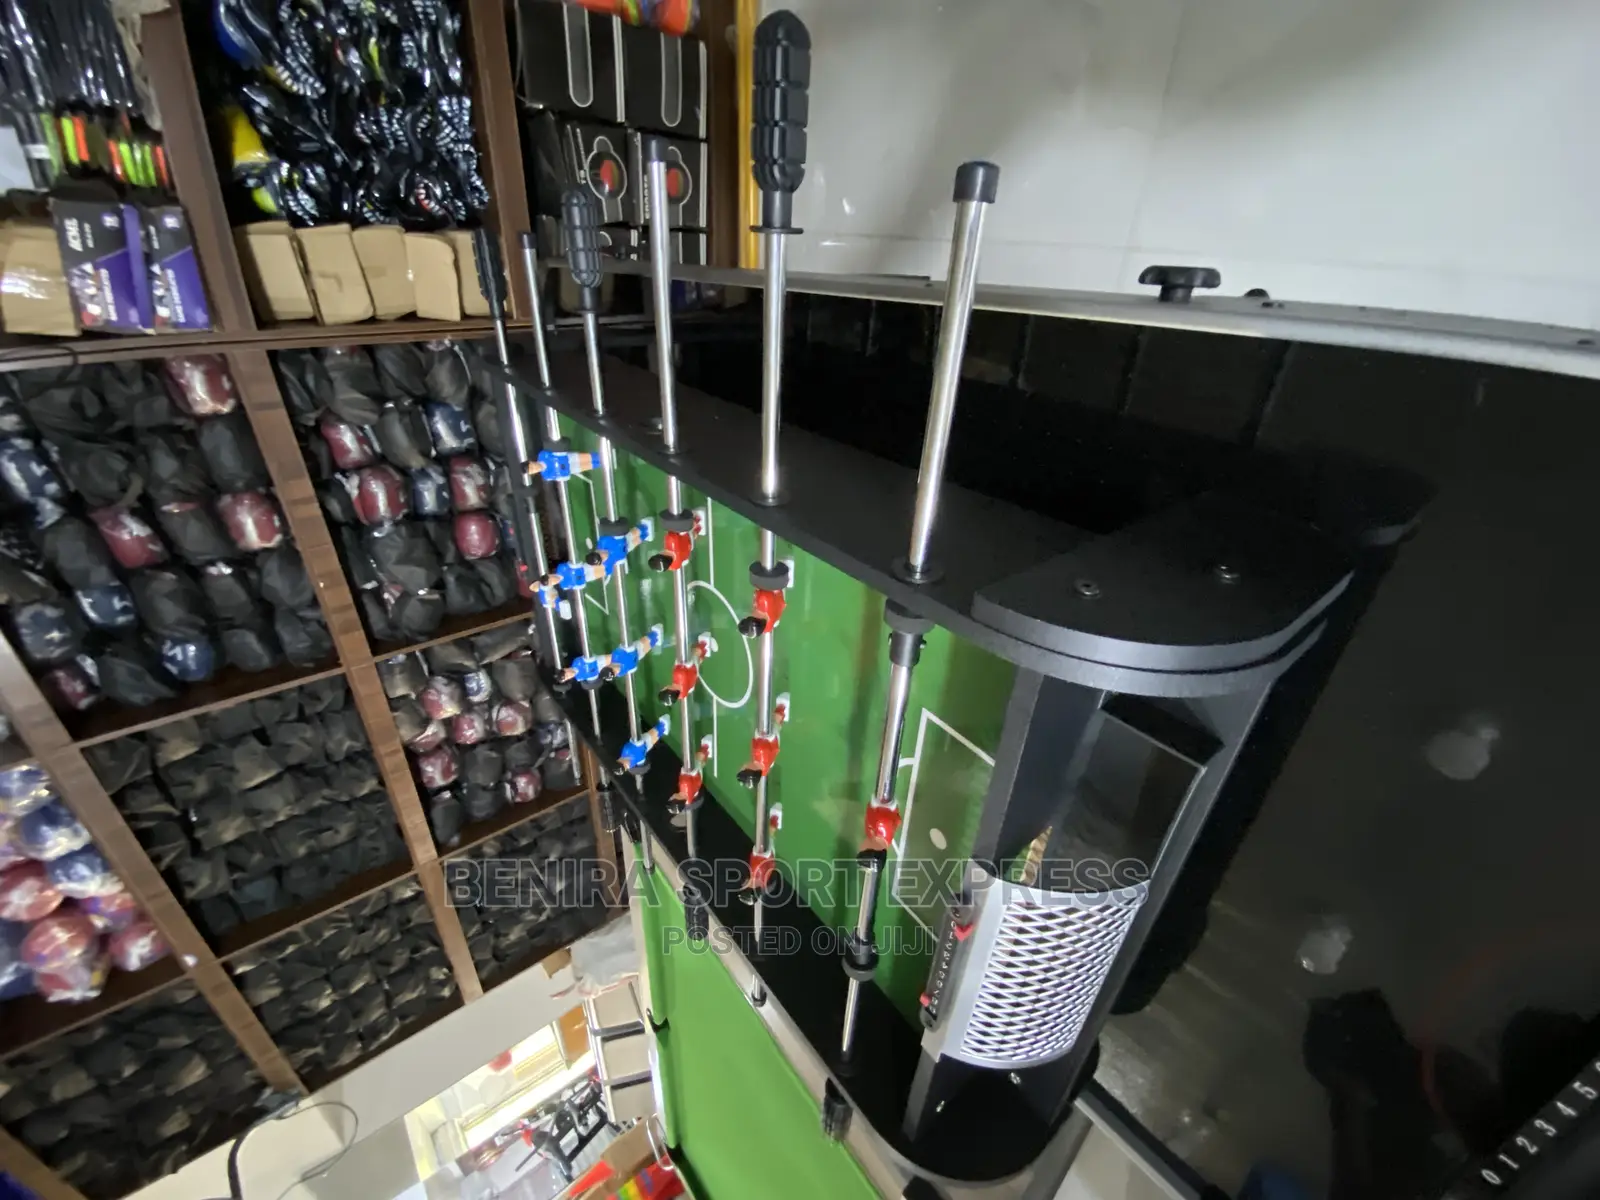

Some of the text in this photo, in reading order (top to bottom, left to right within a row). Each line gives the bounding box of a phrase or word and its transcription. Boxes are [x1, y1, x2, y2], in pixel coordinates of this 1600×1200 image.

[1481, 1081, 1598, 1185] 0 1 2 3 4 5
